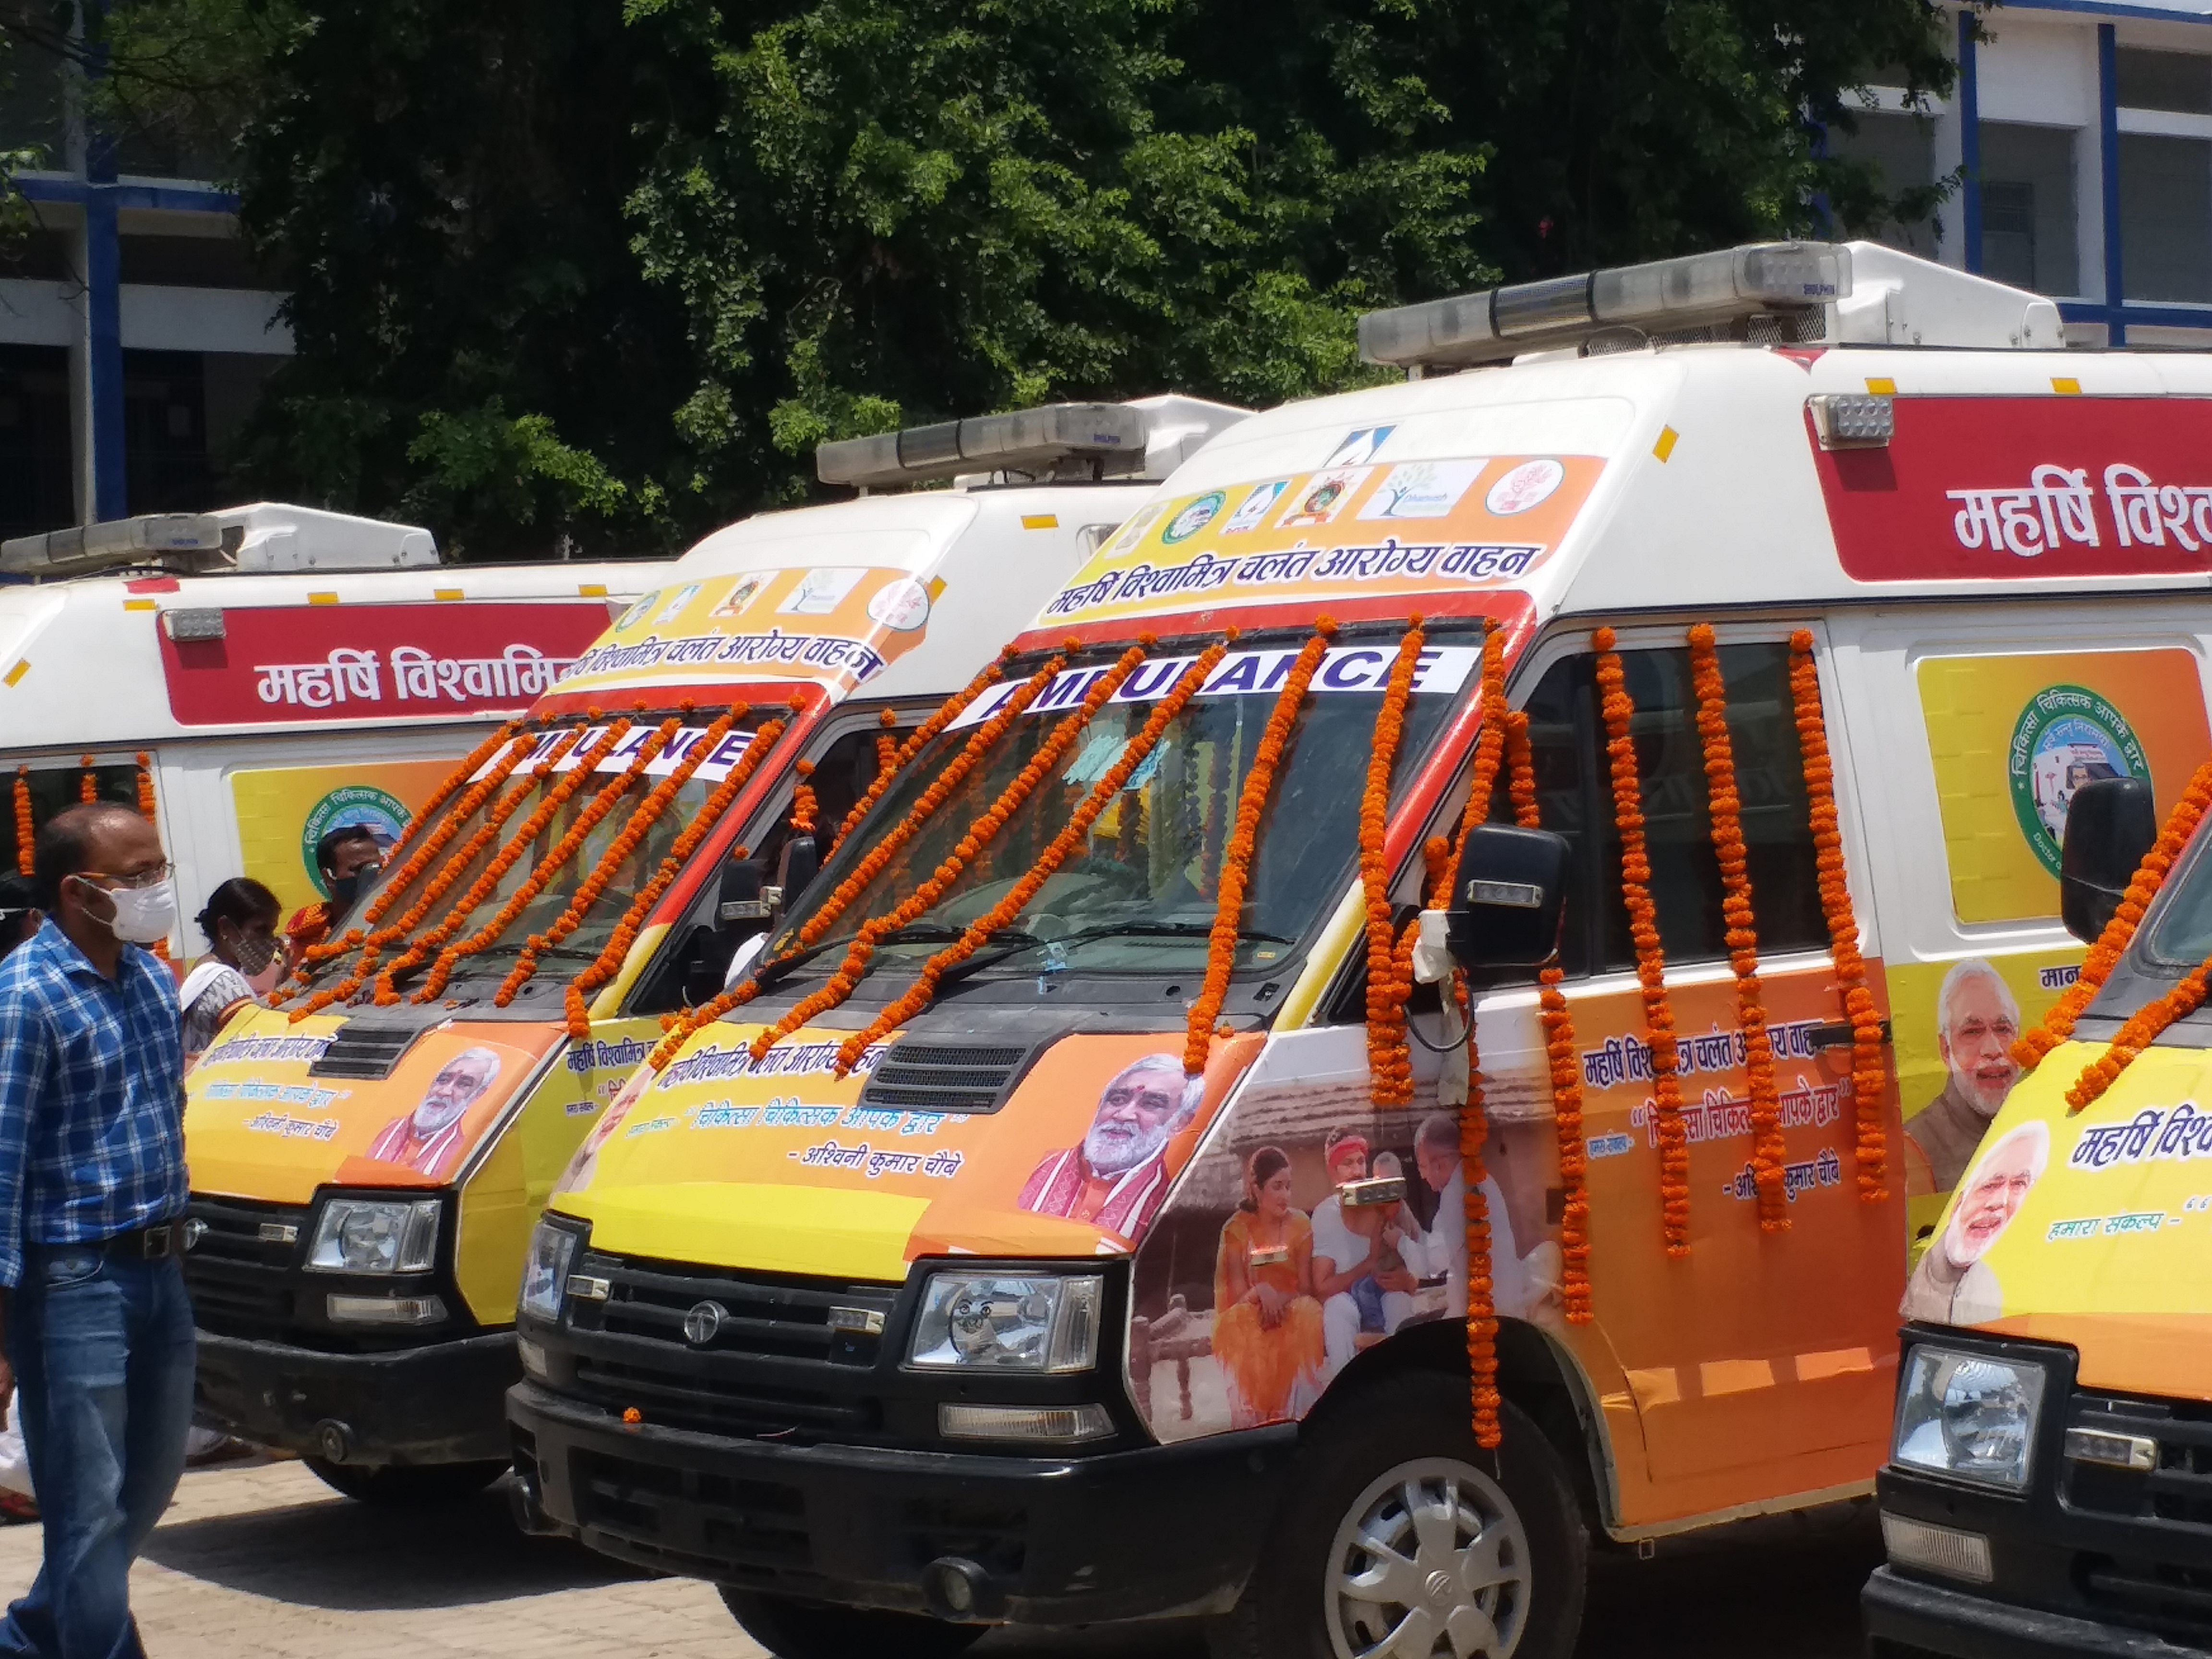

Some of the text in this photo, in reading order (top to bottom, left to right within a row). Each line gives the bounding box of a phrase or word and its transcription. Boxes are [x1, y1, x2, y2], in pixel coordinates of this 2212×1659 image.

[1946, 463, 2100, 557] महर्षि
[1046, 538, 1541, 614] महर्षि विश्वामित्र चलंत आरोग्य वाहन
[253, 643, 578, 708] महर्षि विश्वामि
[719, 629, 811, 661] आरोग्य
[978, 651, 1443, 719] AMUANCE
[1583, 1039, 1624, 1086] महर्षि
[1695, 1023, 1733, 1070] चलंत
[1786, 1020, 1824, 1058] वाह
[802, 1141, 868, 1166] अश्विनी
[867, 1152, 922, 1176] कुमार
[924, 1151, 963, 1176] चौबे
[2071, 1109, 2165, 1166] महर्षि
